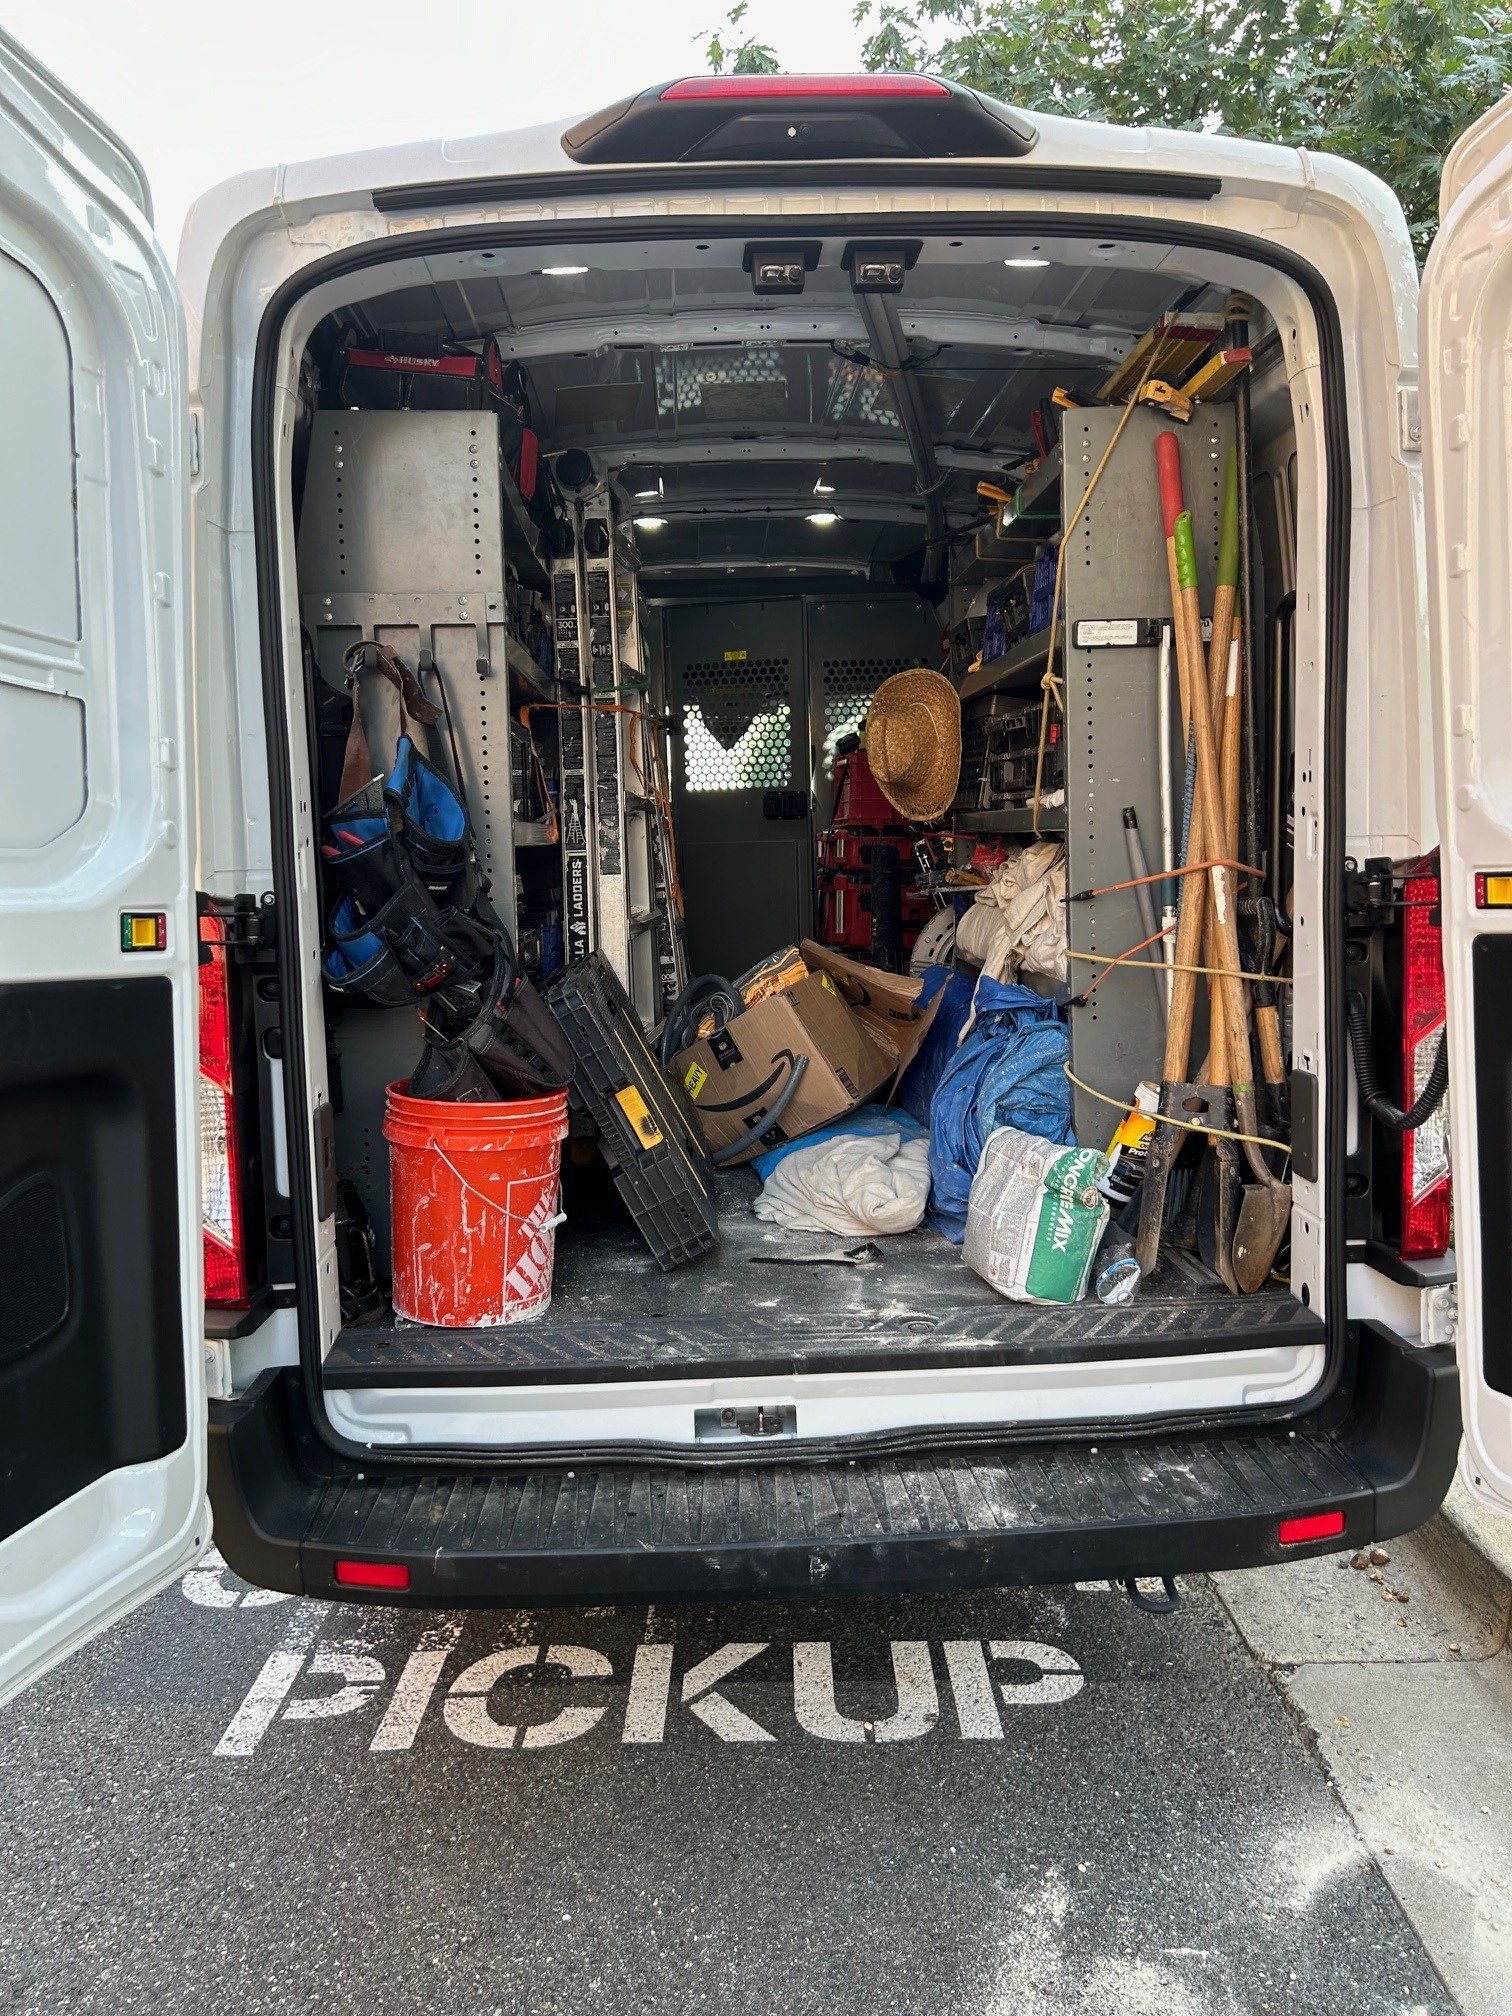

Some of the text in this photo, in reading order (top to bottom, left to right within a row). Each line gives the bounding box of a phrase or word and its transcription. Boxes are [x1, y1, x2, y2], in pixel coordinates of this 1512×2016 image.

[399, 355, 440, 367] HUSKY
[557, 620, 574, 629] 300
[572, 858, 584, 918] LADDERS
[687, 1066, 703, 1095] HEAVY
[1051, 1206, 1075, 1253] MIX
[212, 1640, 1085, 1756] PICKUP
